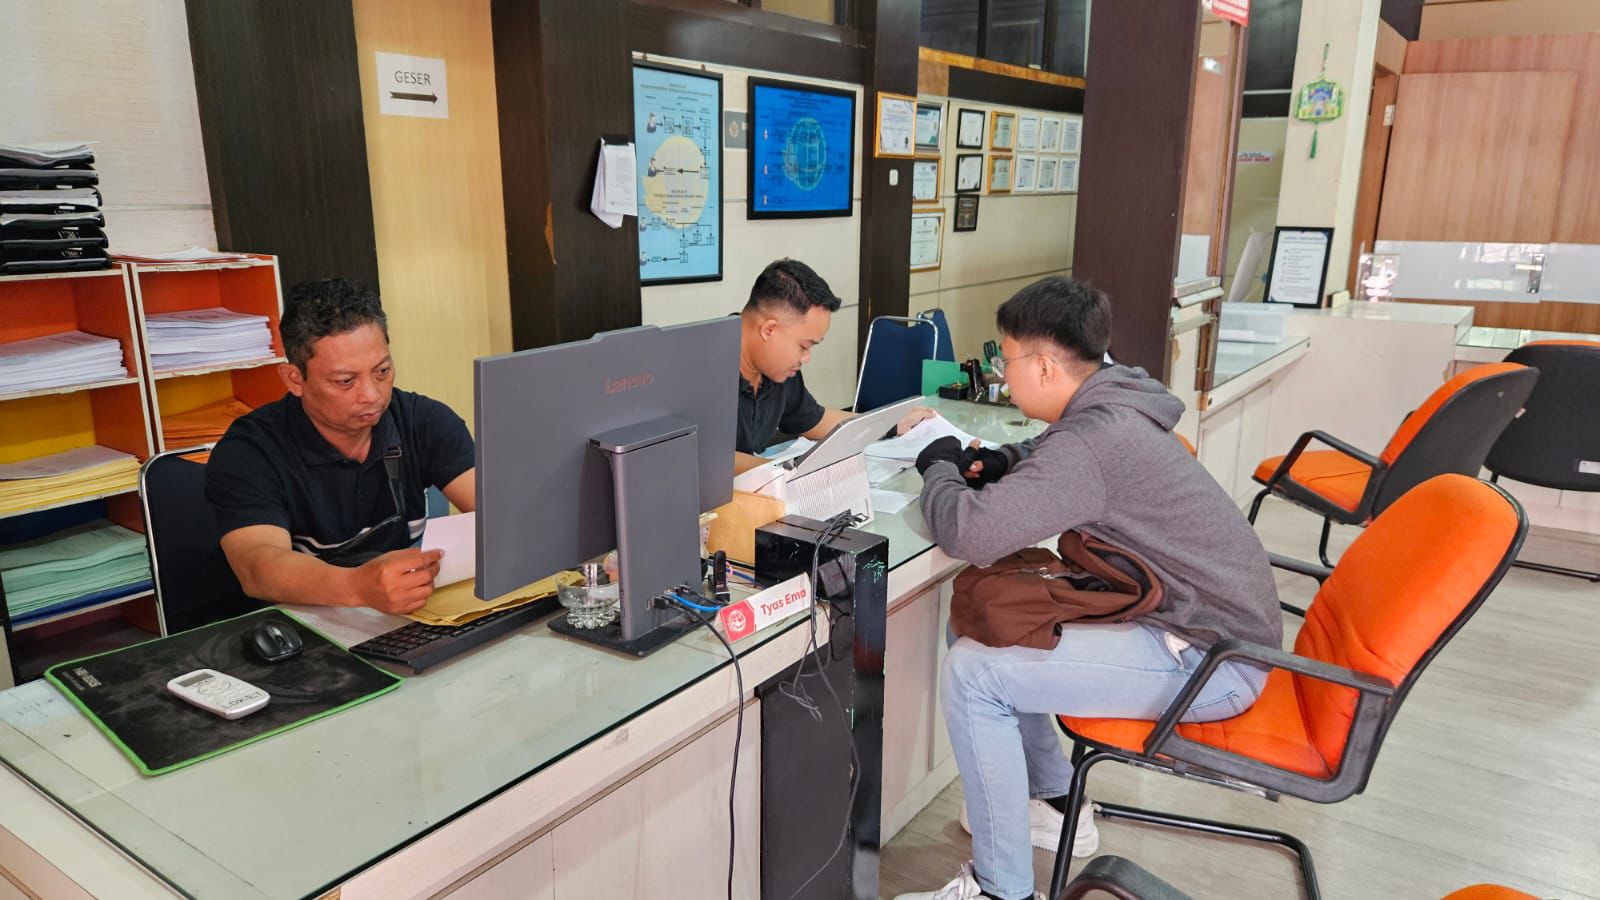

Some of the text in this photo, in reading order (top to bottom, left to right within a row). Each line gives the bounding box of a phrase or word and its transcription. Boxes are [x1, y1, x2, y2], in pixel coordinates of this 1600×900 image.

[394, 70, 431, 86] GESER
[604, 371, 655, 392] Lenovo
[760, 588, 806, 616] Tyas Ema
